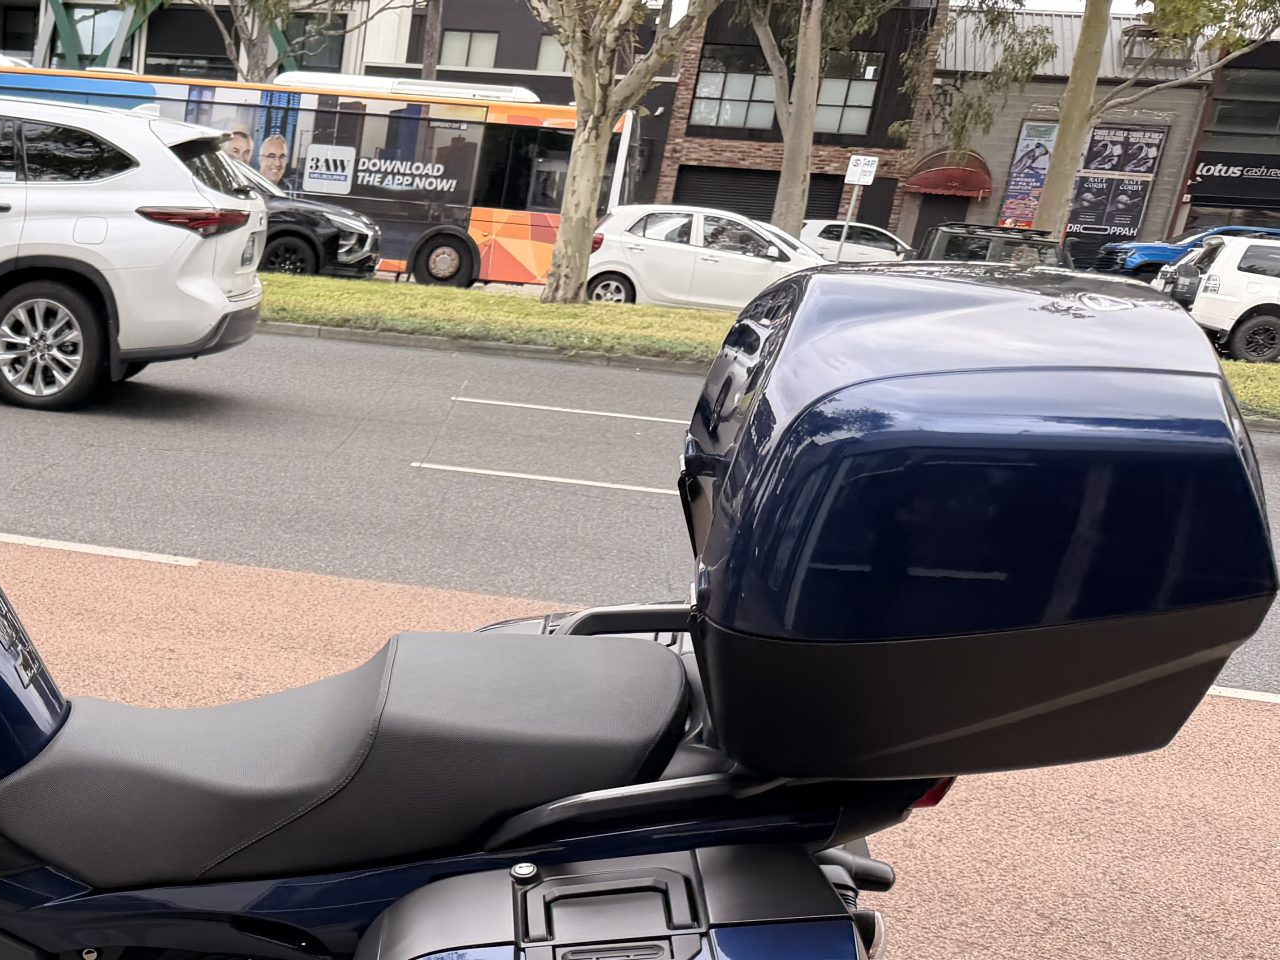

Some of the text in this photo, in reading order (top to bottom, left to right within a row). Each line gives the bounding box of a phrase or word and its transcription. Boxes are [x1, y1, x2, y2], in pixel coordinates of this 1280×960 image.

[309, 157, 350, 173] 3AW
[358, 158, 444, 176] DOWNLOAD
[1196, 162, 1243, 177] lotus
[1243, 166, 1266, 176] cash
[357, 172, 457, 192] THE APP NOW!
